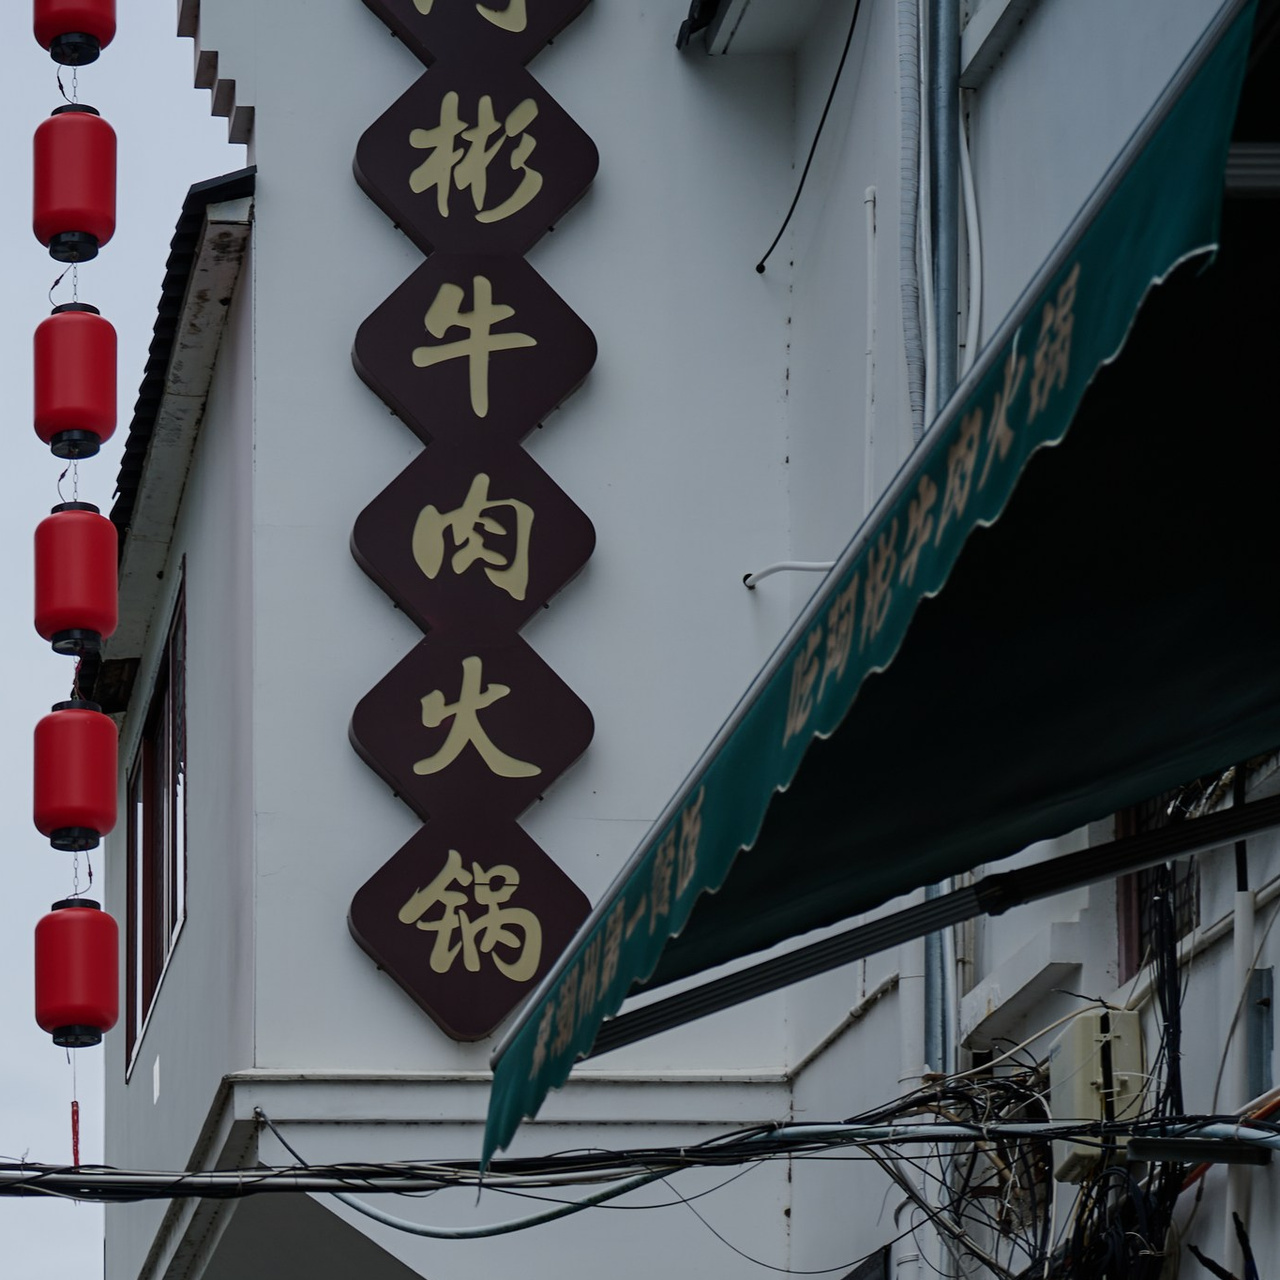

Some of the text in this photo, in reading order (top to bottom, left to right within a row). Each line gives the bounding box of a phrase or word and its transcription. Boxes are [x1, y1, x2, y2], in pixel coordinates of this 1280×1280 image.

[398, 0, 544, 982] 彬牛肉火锅
